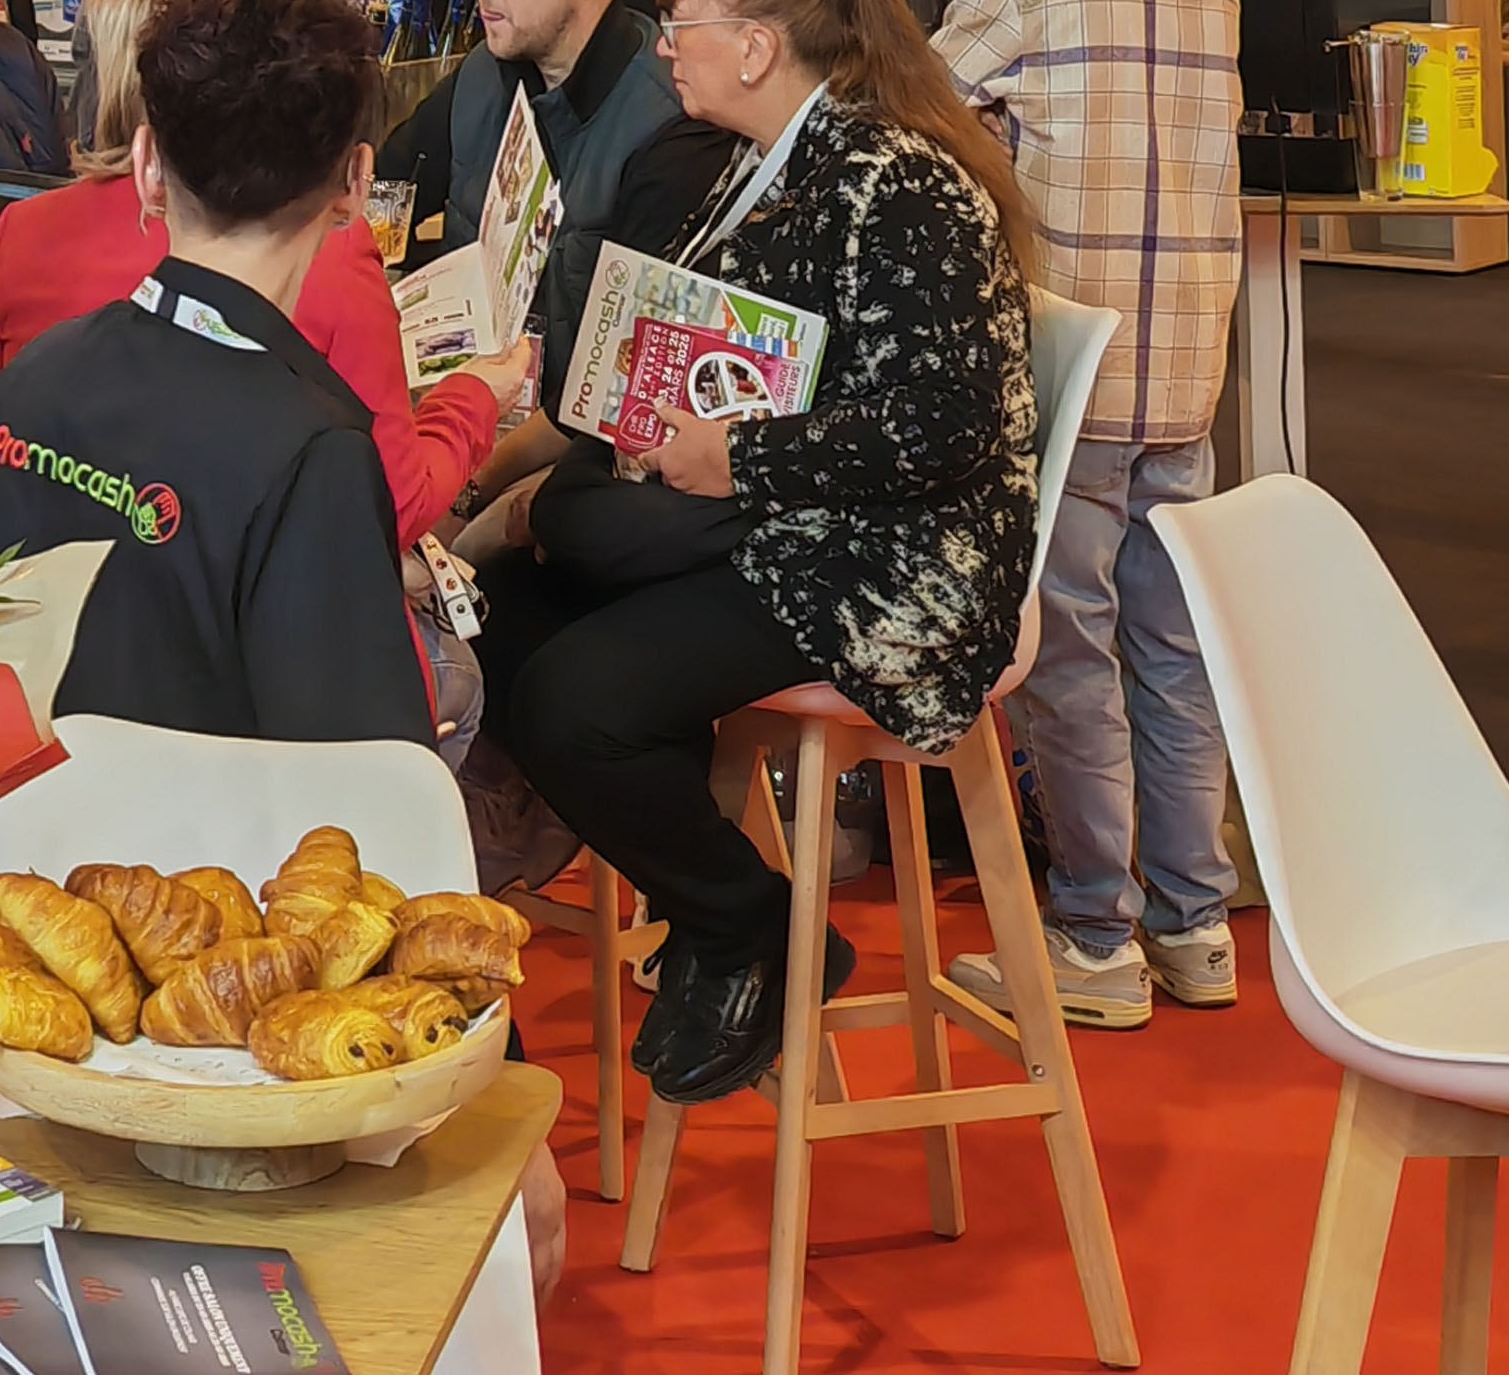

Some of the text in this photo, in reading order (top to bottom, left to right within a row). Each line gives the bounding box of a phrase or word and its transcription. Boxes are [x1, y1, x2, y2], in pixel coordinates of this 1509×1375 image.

[572, 288, 619, 419] Promocash
[668, 333, 690, 405] MARS 2025
[775, 363, 790, 397] GUIDE
